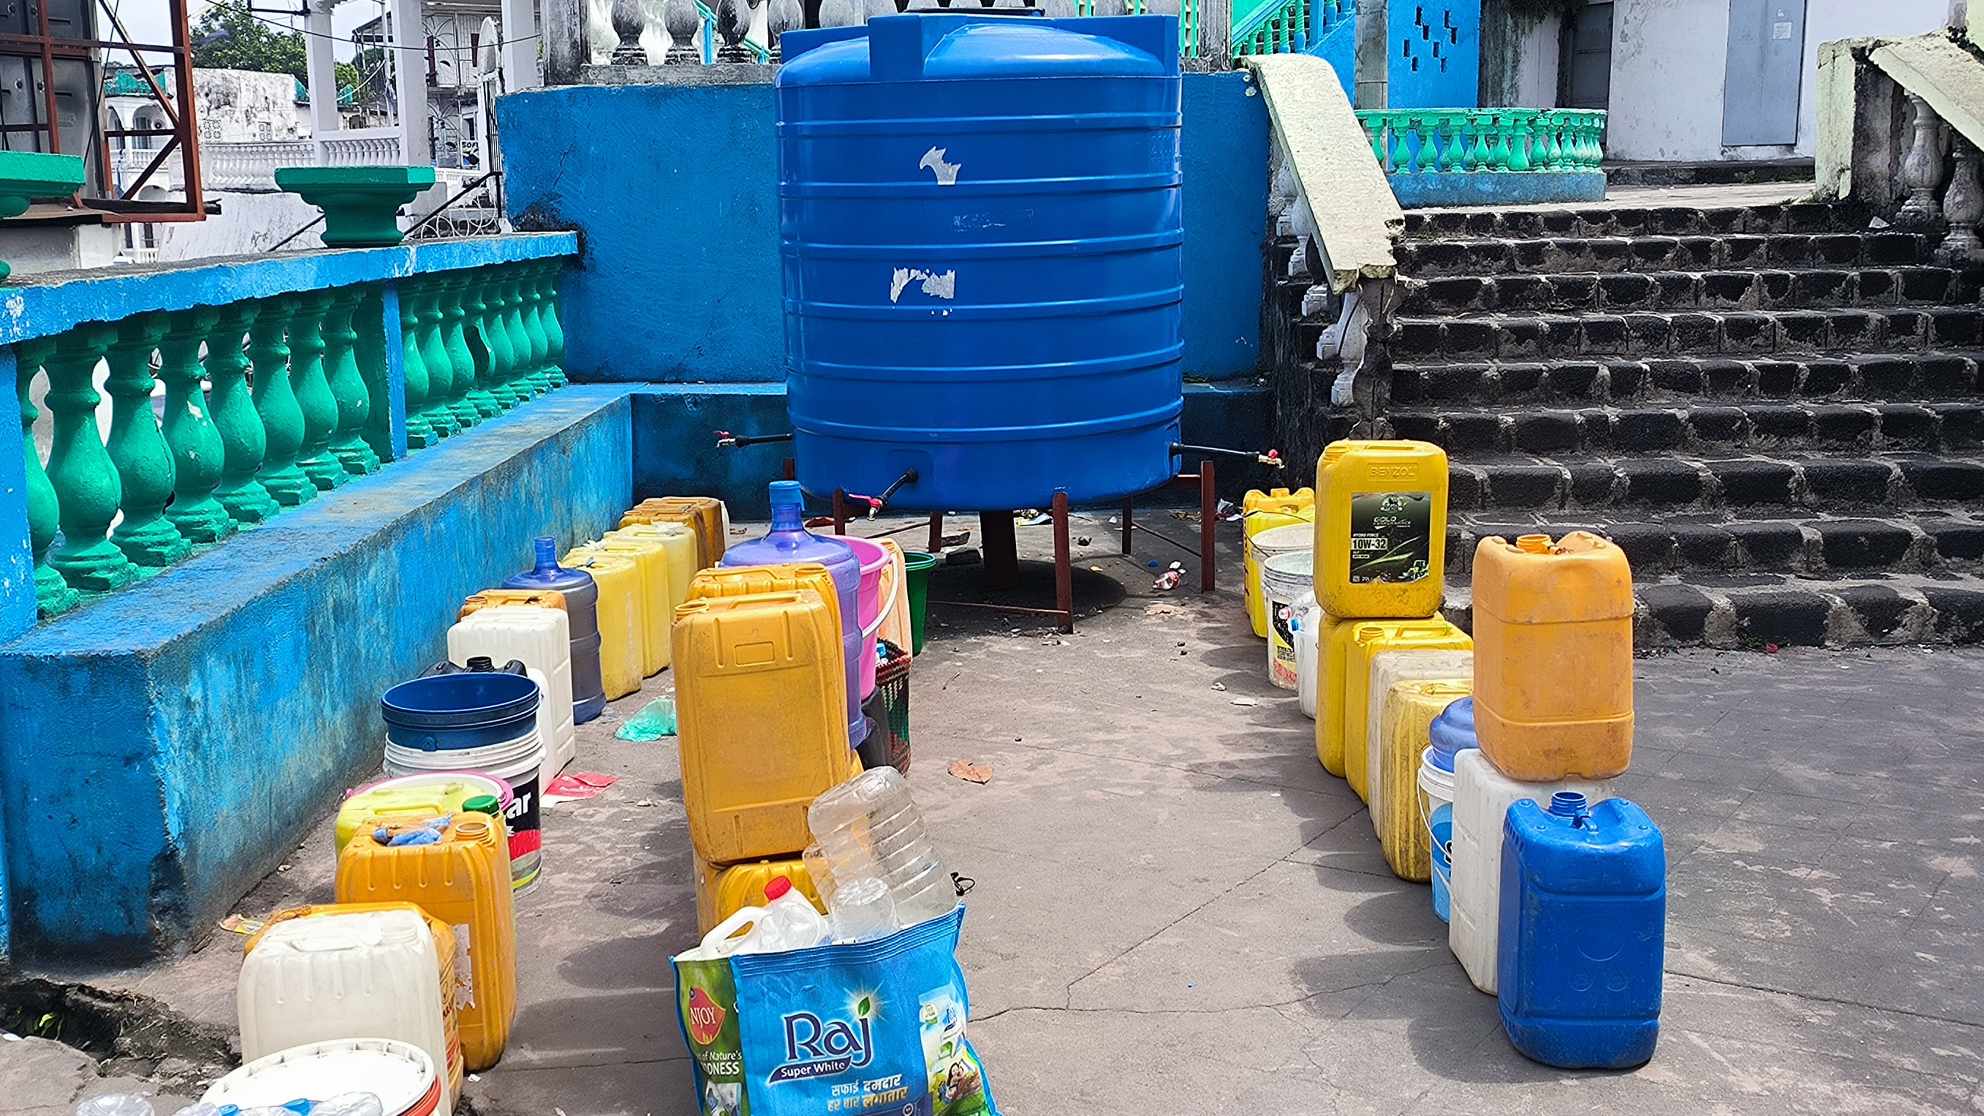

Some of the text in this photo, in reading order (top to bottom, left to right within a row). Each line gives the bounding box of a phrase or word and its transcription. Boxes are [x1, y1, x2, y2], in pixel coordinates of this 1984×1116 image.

[1353, 539, 1386, 549] 10W-32
[783, 1013, 872, 1067] Raj
[709, 1050, 742, 1061] Nature's
[781, 1061, 845, 1078] Super White
[863, 1074, 903, 1092] दमदार
